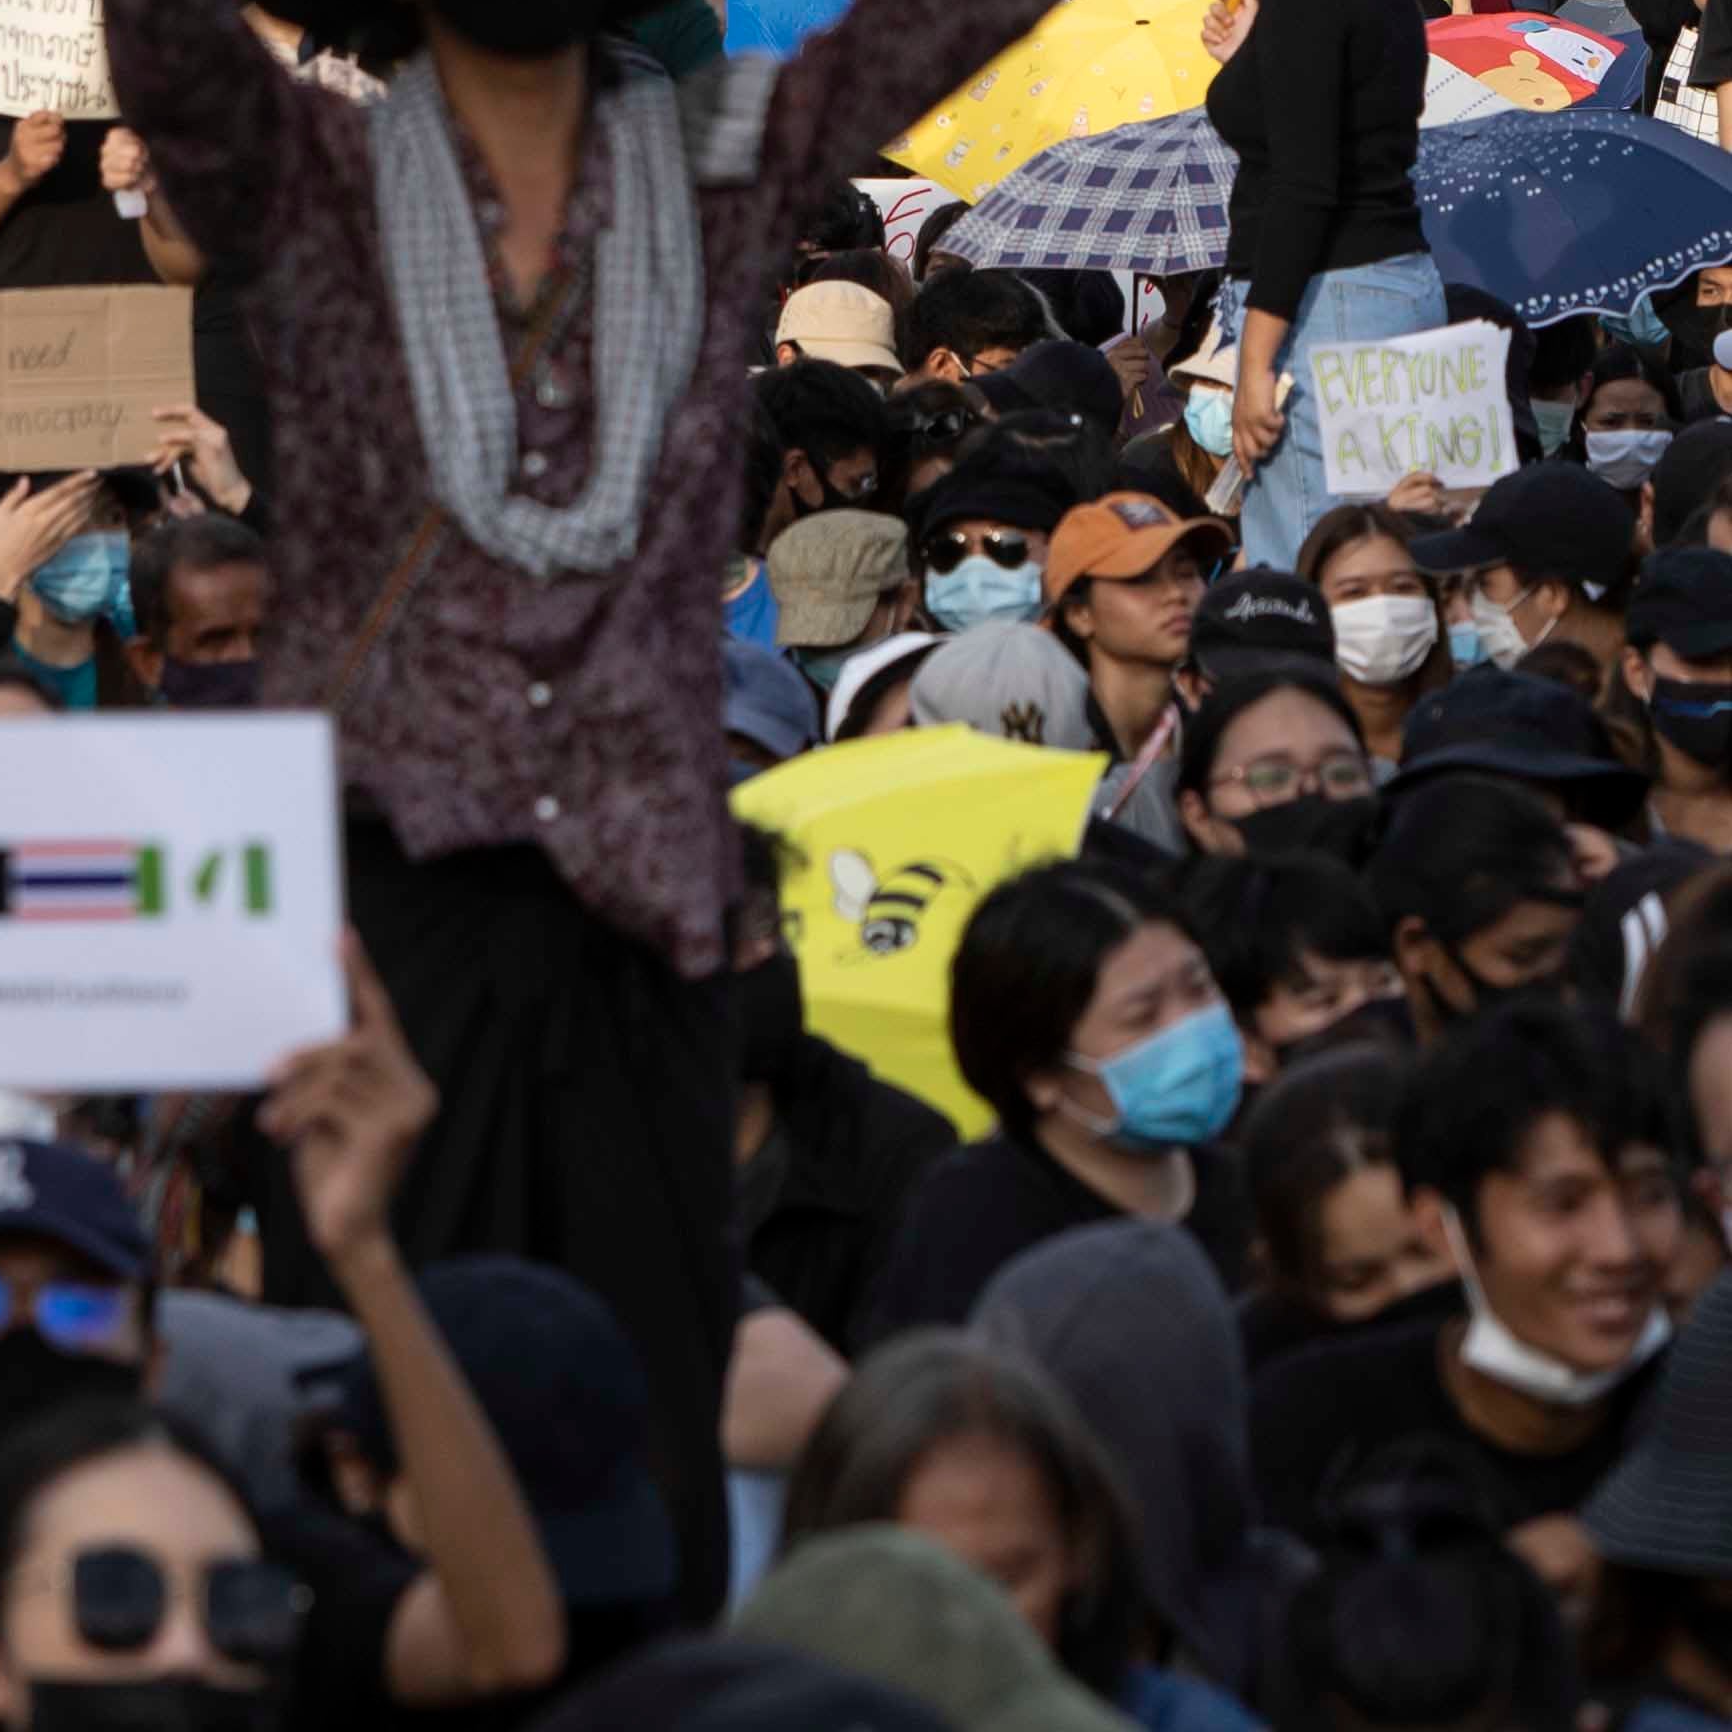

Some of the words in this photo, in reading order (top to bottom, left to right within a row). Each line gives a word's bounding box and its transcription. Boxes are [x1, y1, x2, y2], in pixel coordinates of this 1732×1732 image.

[1312, 343, 1489, 414] EVERYONE
[1337, 429, 1371, 475] A
[1383, 403, 1506, 474] KING!
